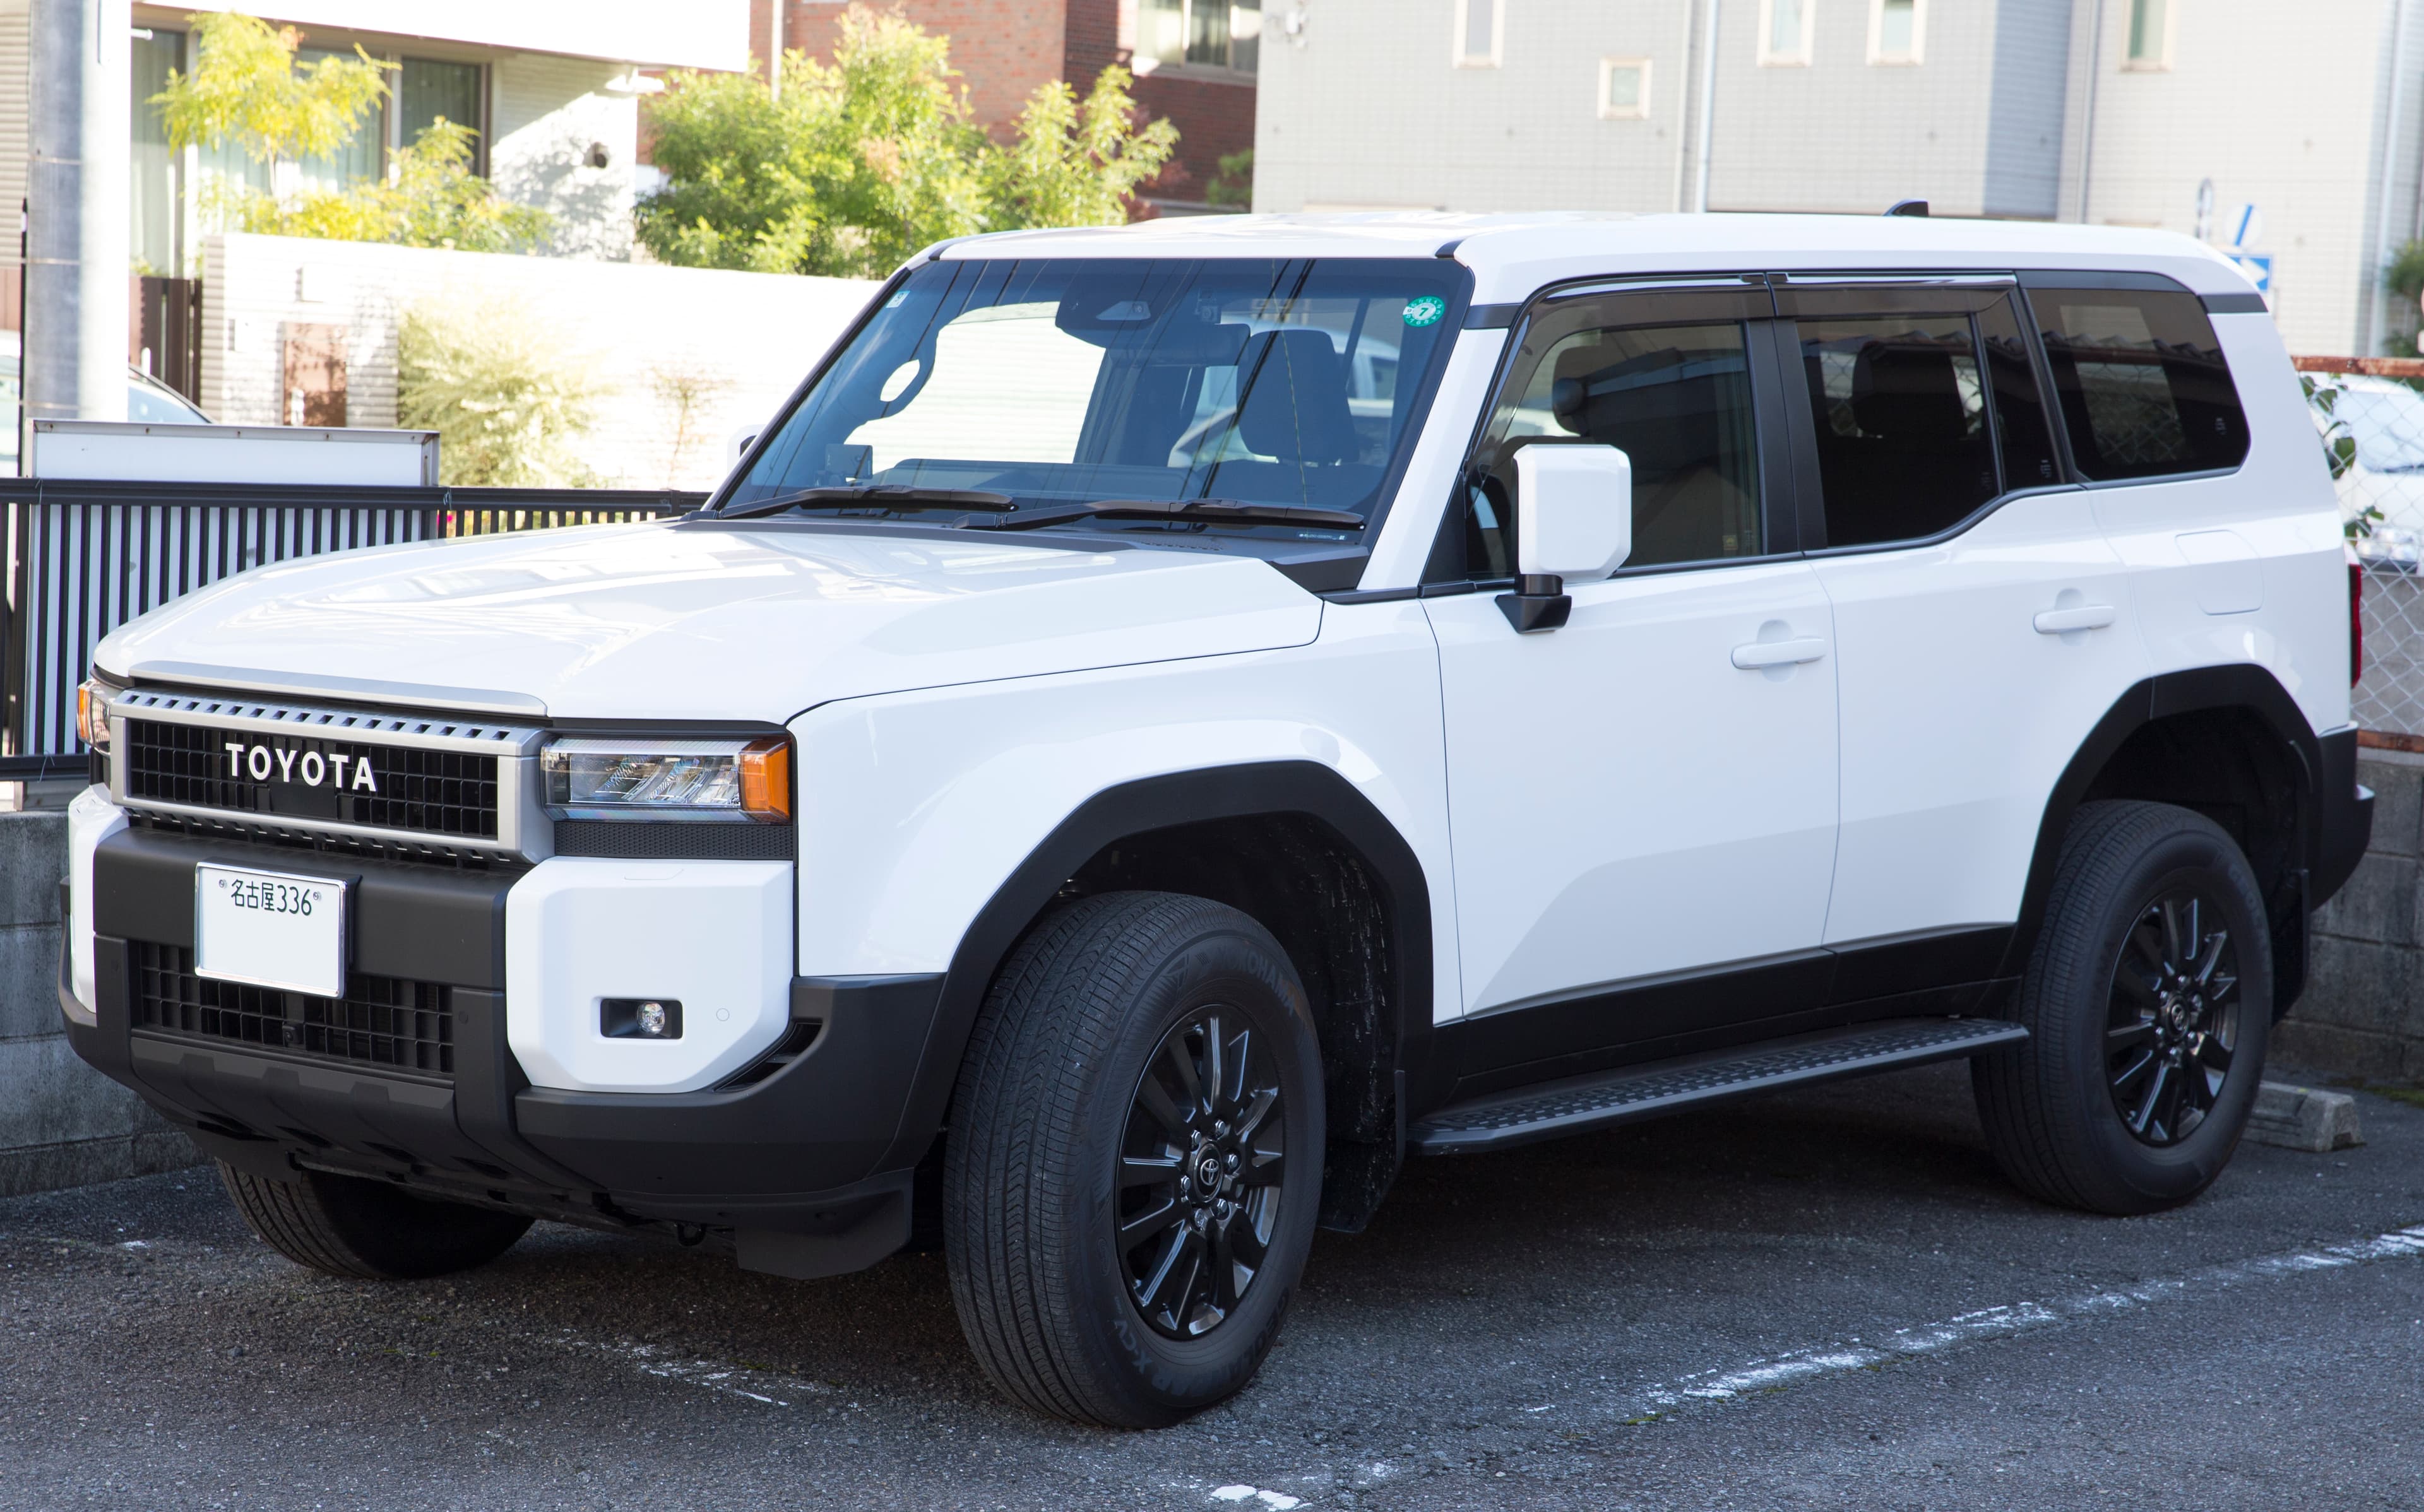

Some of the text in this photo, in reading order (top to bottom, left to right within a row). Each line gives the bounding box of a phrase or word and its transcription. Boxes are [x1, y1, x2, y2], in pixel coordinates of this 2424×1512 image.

[1419, 307, 1429, 317] 7
[225, 742, 377, 792] TOYOTA
[231, 878, 312, 916] 名古屋336
